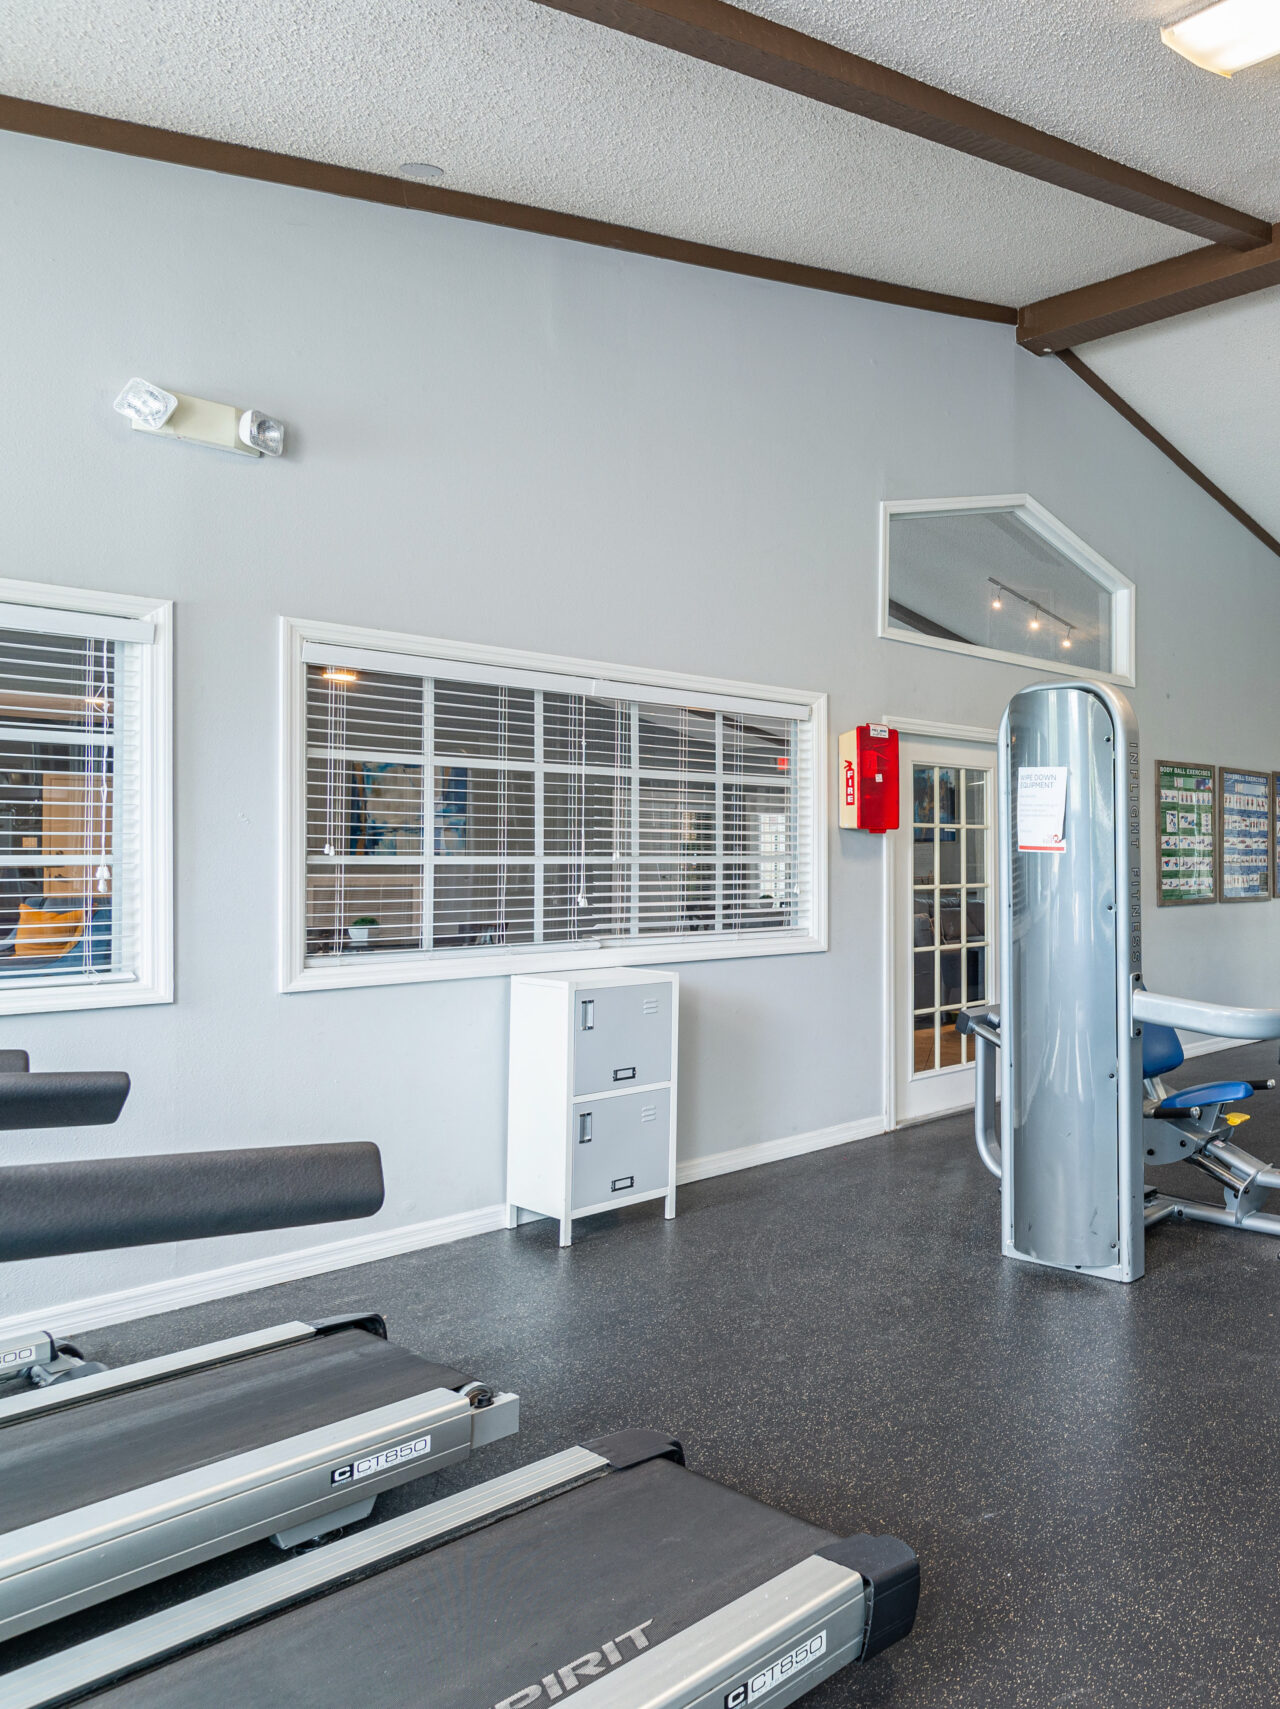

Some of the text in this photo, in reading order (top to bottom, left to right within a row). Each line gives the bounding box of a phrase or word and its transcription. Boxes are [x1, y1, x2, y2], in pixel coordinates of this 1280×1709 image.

[1020, 781, 1054, 789] EQUIPMENT
[1186, 769, 1211, 777] EXERCISES
[1129, 742, 1140, 962] INFLIGHT FITNESS
[0, 1348, 33, 1364] 00
[334, 1466, 351, 1482] C
[356, 1438, 427, 1474] CT850
[488, 1618, 655, 1709] PIRIT
[728, 1635, 823, 1709] C CT850
